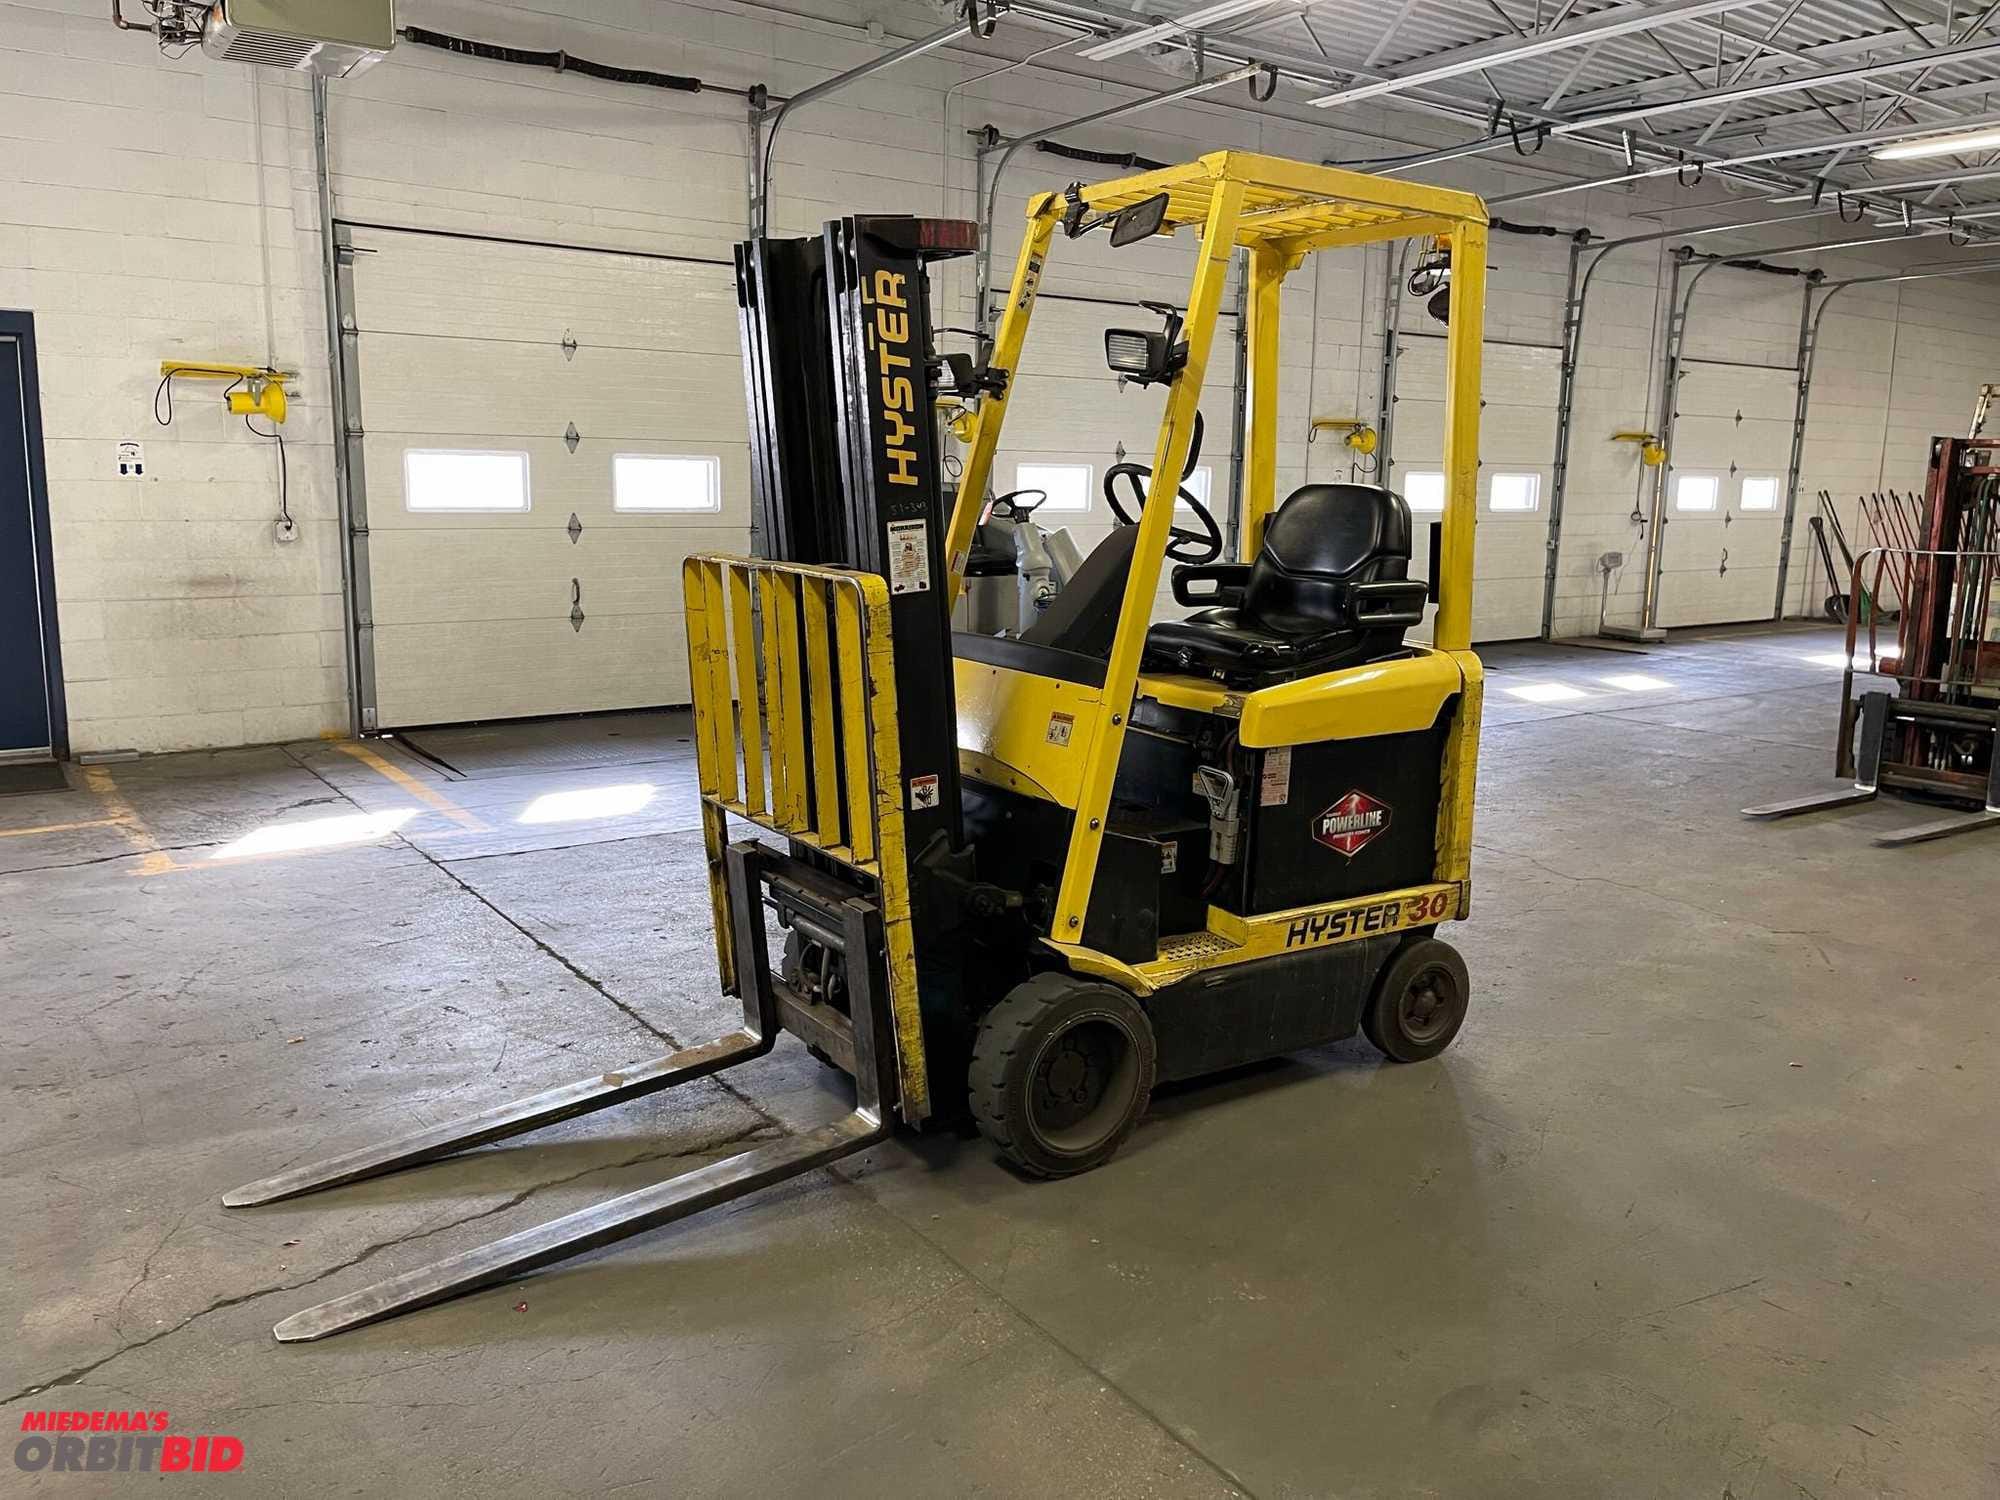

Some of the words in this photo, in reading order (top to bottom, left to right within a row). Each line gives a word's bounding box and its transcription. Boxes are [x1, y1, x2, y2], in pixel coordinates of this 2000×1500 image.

[874, 269, 918, 486] HYSTER
[1323, 810, 1382, 835] POWERLINE
[1287, 904, 1400, 947] HYSTER
[1404, 892, 1448, 922] 30
